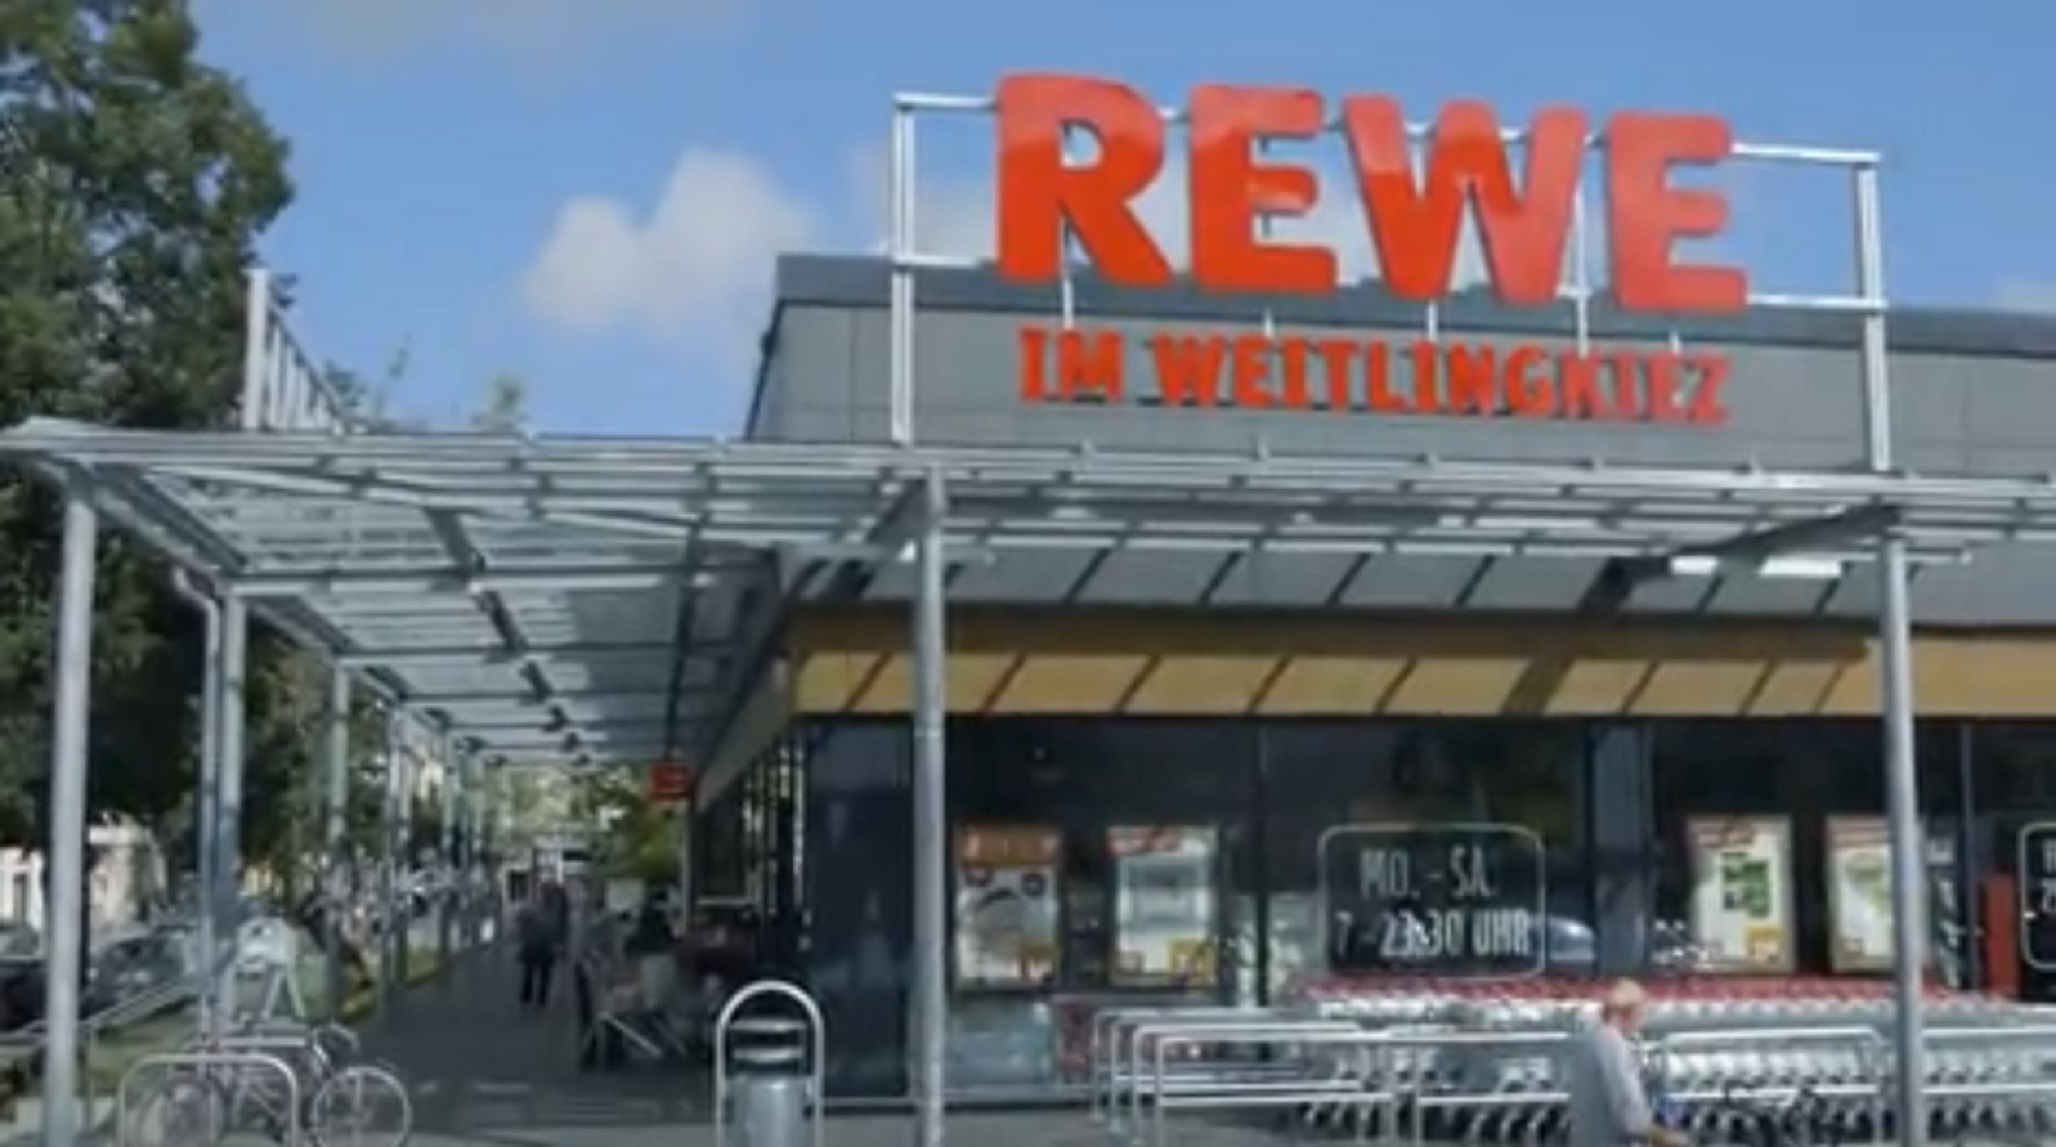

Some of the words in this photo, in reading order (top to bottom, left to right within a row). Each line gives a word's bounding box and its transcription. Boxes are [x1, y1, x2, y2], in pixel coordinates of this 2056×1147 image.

[995, 72, 1748, 314] REWE
[1019, 328, 1122, 402] IM
[1146, 332, 1730, 424] WEITLINGKIEZ
[1472, 907, 1530, 955] UHR
